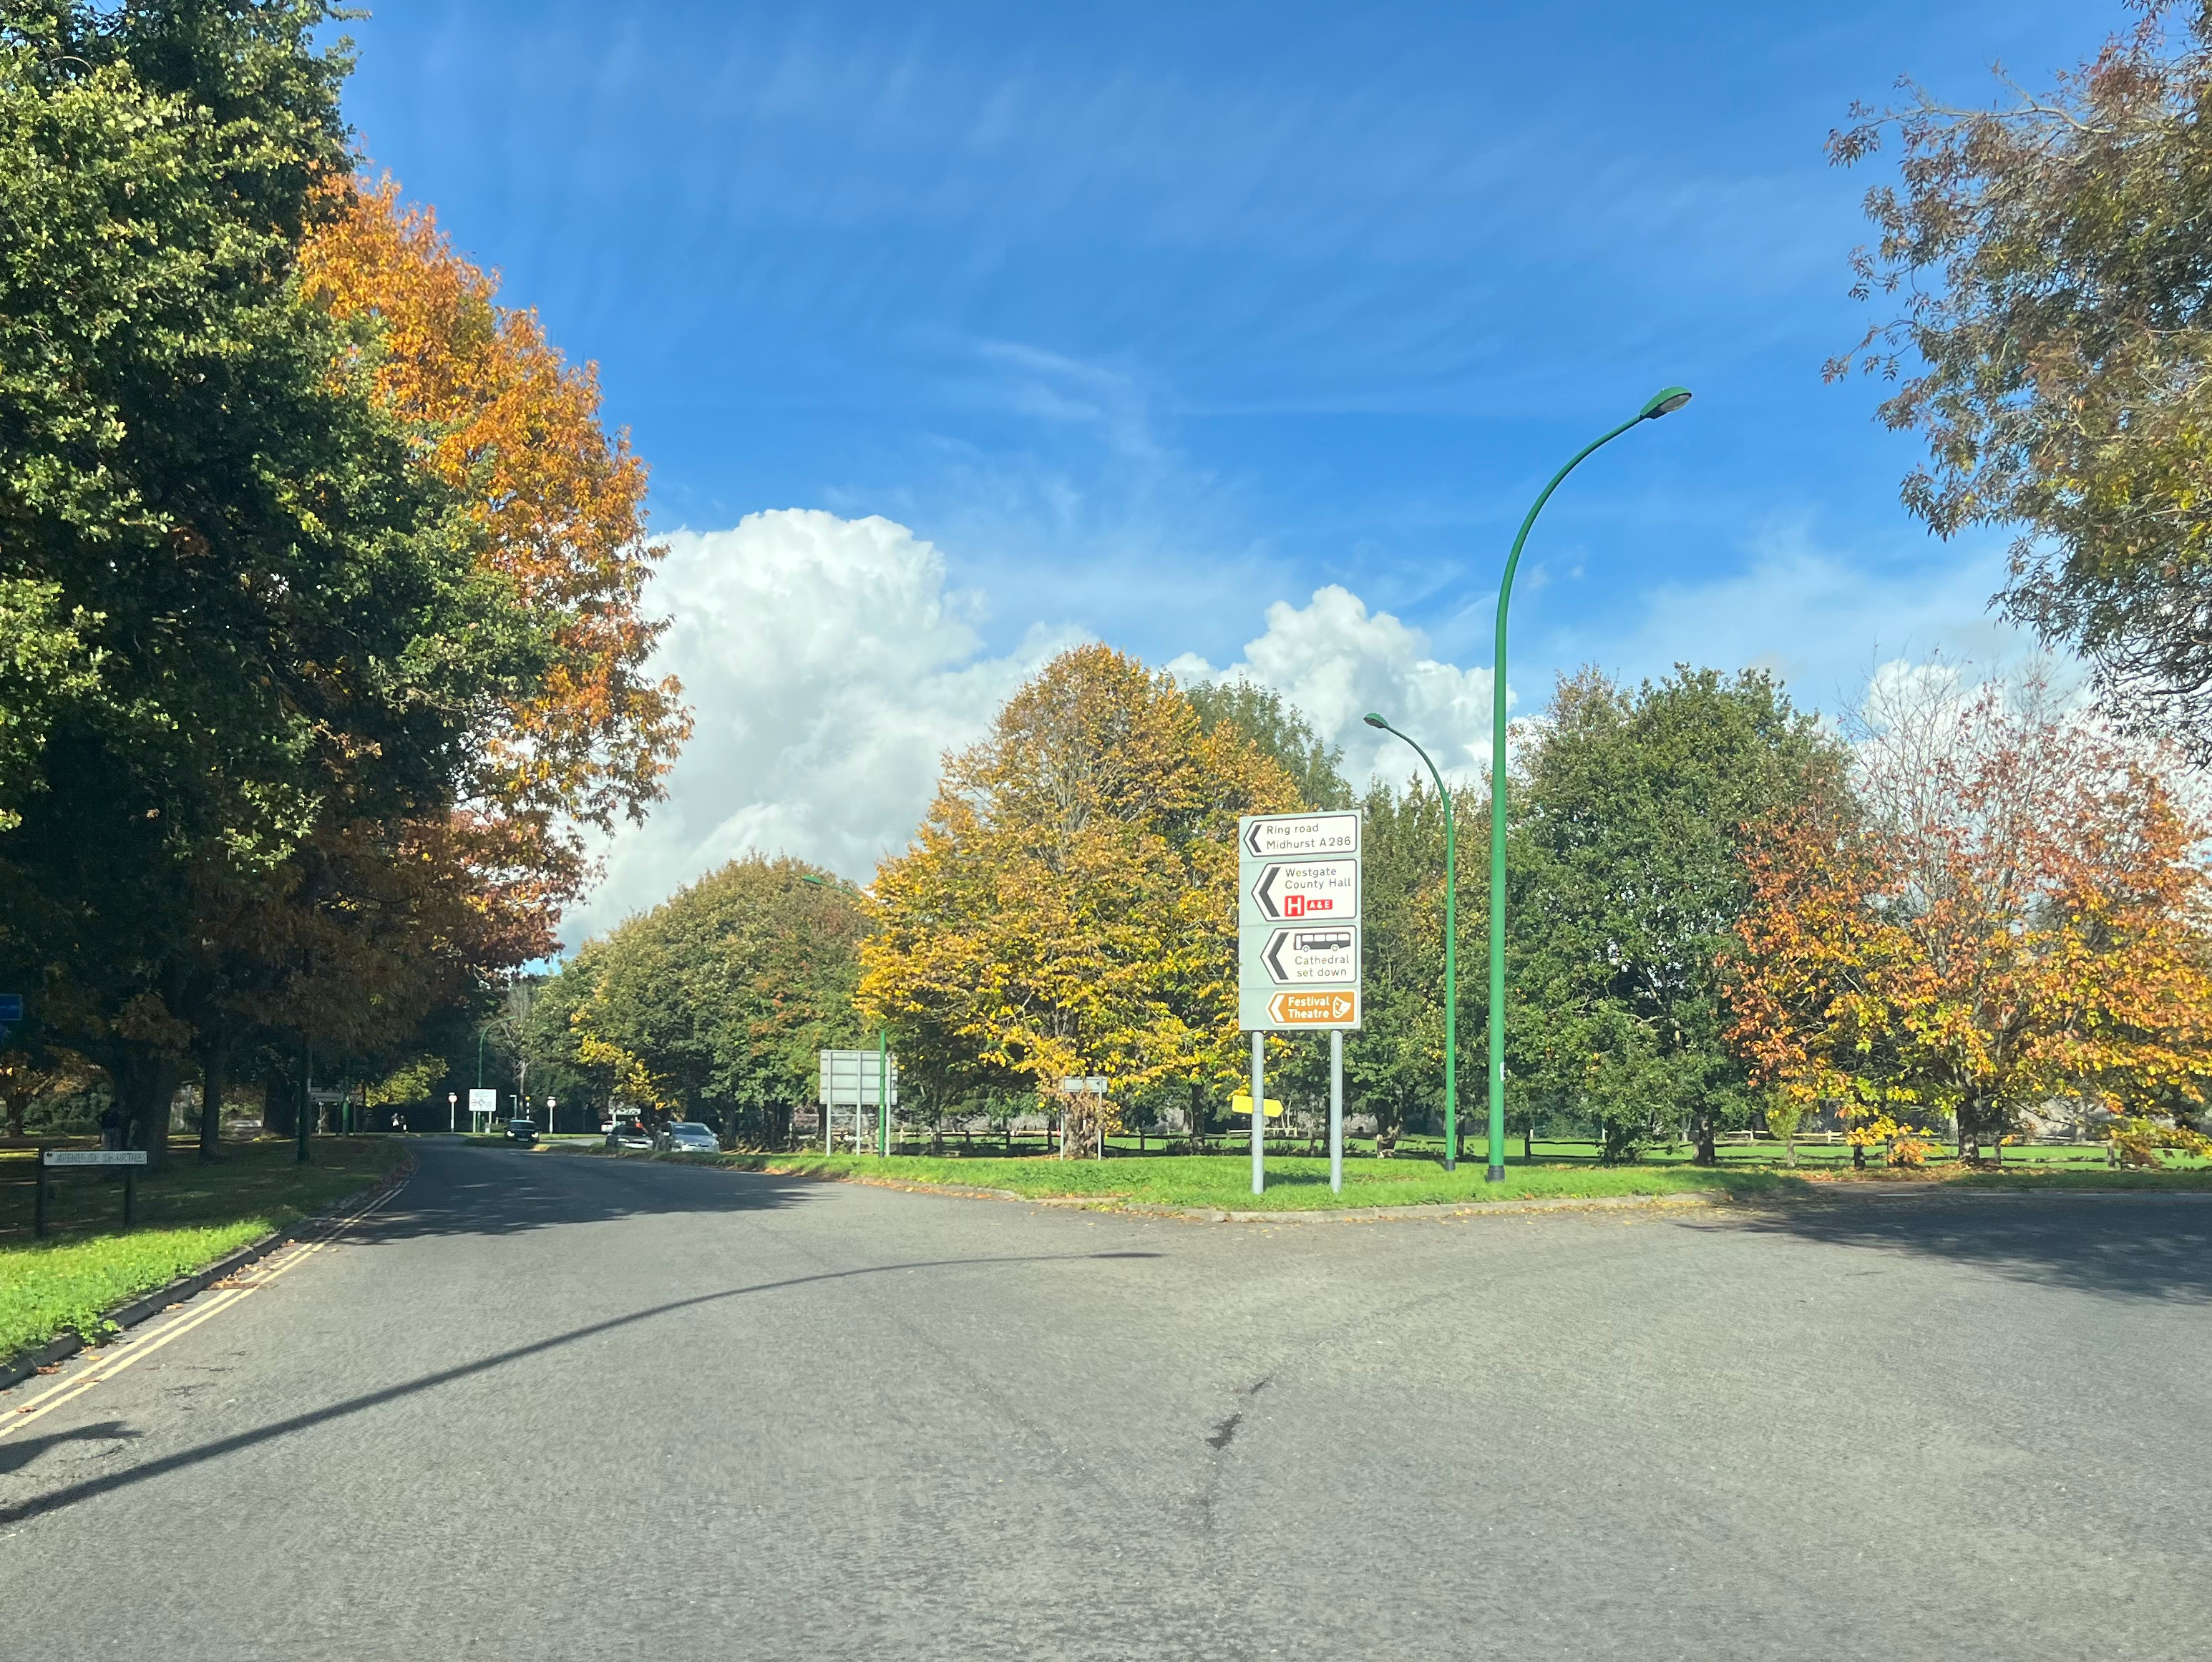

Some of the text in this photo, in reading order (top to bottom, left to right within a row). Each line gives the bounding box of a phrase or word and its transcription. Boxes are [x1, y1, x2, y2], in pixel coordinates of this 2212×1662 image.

[1267, 823, 1319, 835] Ring road
[1267, 836, 1351, 849] Midhurst A286
[1285, 868, 1337, 878] Westgate
[1285, 877, 1351, 890] County Hall
[1287, 897, 1302, 915] H
[1295, 954, 1350, 965] Cathedral
[1297, 967, 1347, 977] set down
[1288, 995, 1330, 1007] Festival
[1288, 1008, 1330, 1019] Theatre
